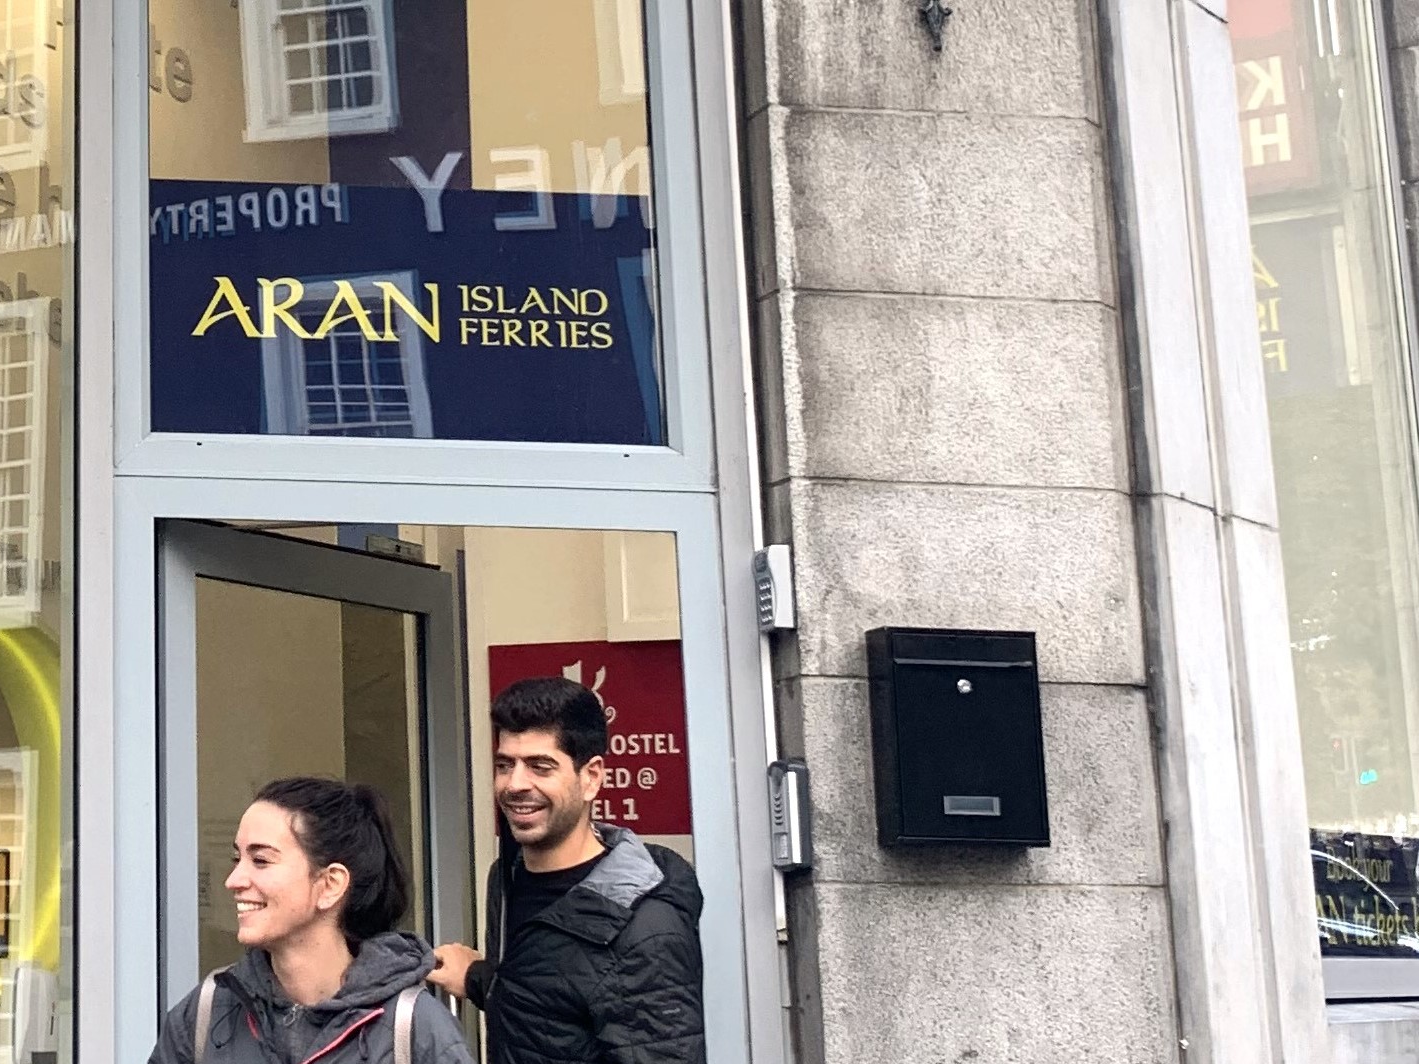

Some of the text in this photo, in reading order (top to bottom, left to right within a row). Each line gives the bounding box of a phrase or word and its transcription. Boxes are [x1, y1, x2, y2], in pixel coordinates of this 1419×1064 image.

[191, 276, 609, 343] ARAN ISLAND
[458, 318, 614, 350] FERRIES
[605, 733, 681, 755] OSTEL
[623, 798, 640, 820] 1
